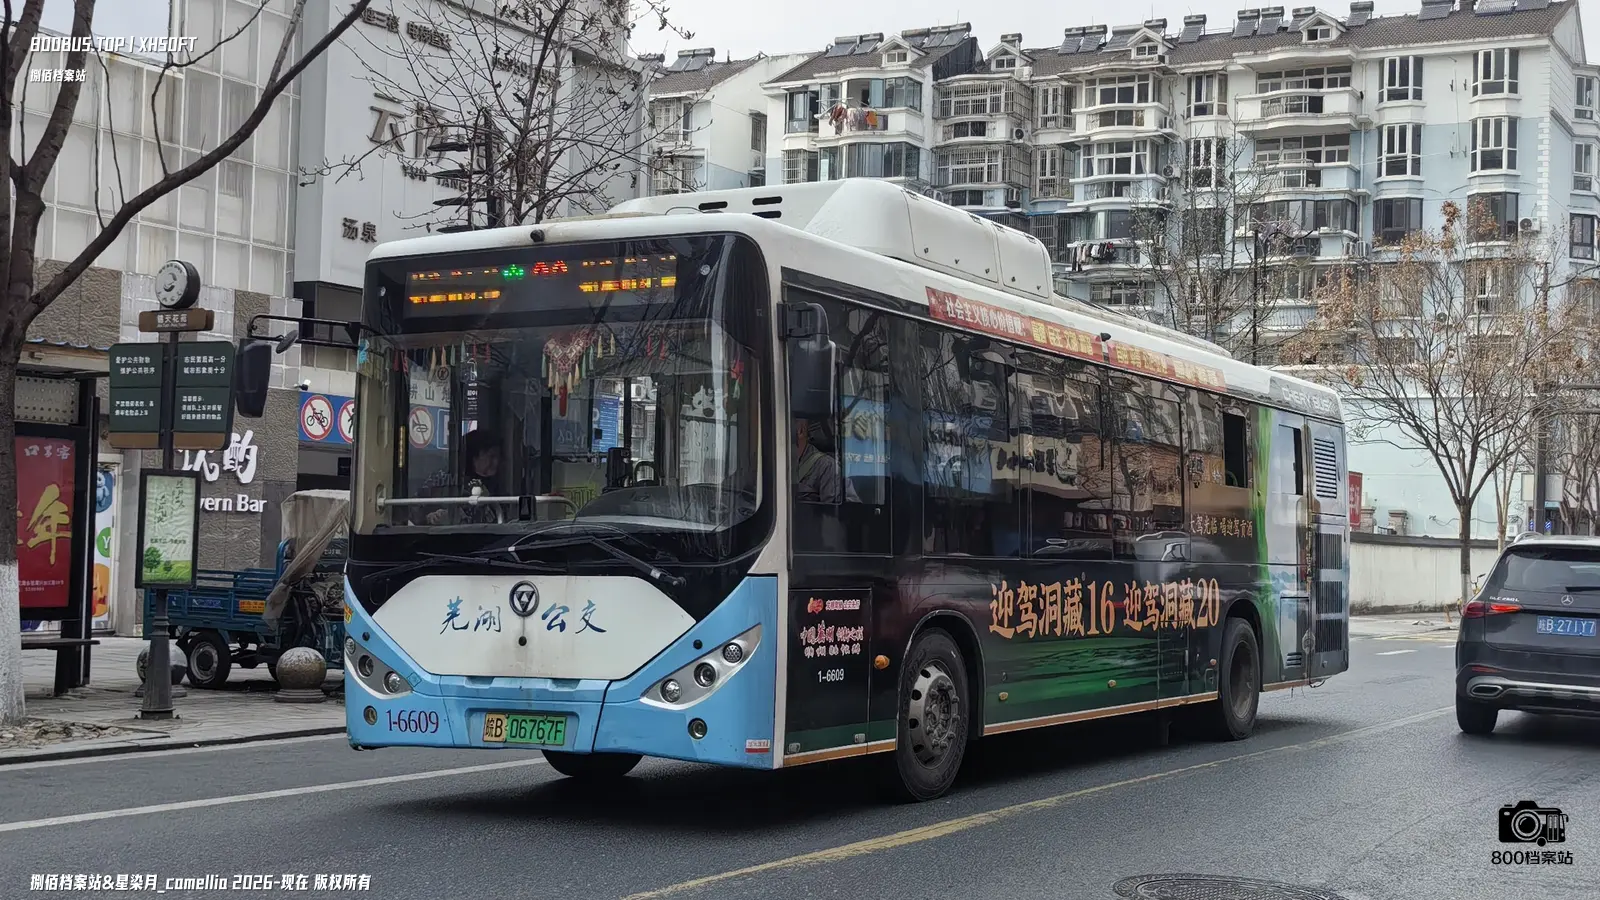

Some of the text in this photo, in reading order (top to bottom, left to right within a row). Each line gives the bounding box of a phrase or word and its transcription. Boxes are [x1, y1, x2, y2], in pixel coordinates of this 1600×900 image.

[342, 217, 378, 243] 汤泉
[237, 494, 268, 512] Bar
[542, 599, 607, 634] 公交
[817, 668, 845, 683] 1-6609
[386, 709, 439, 735] 1-6609
